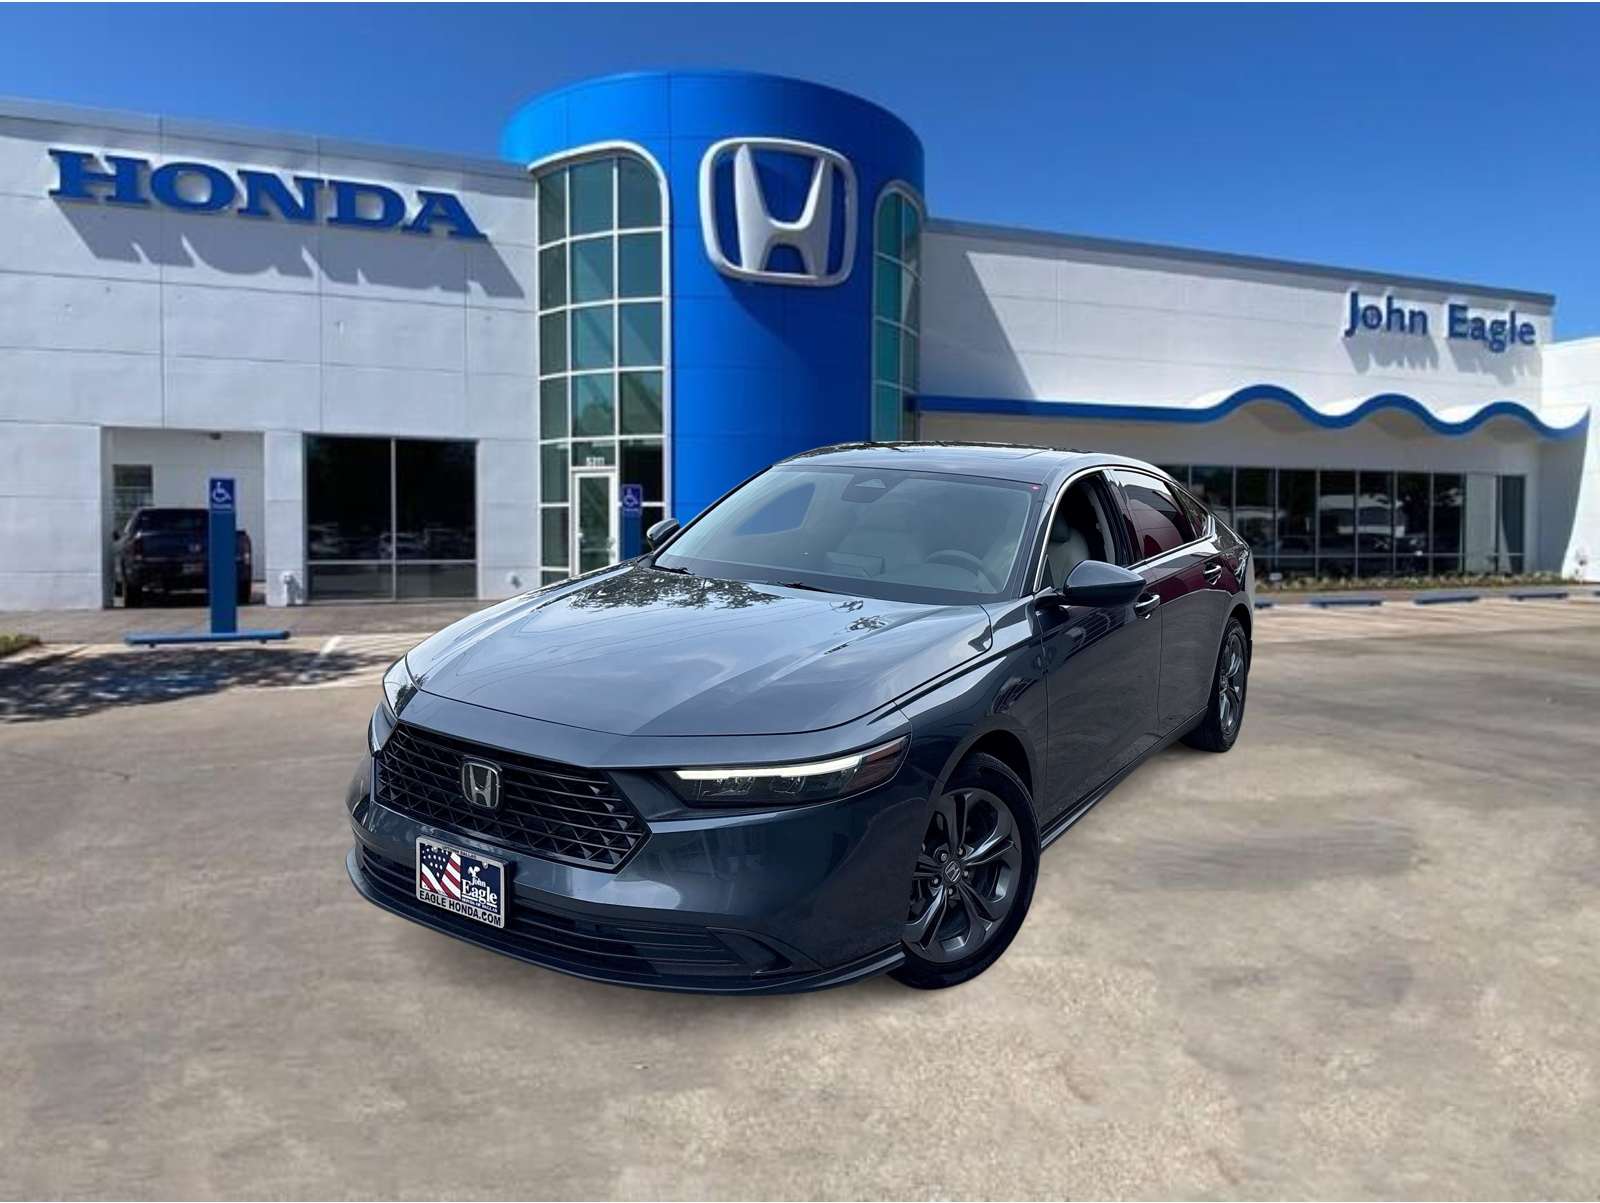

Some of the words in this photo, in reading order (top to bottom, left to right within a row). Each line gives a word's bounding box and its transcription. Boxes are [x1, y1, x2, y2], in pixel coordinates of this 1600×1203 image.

[48, 148, 488, 241] HONDA
[1344, 291, 1428, 338] John
[1448, 303, 1536, 353] Eagle
[461, 879, 498, 905] Eagle
[471, 877, 486, 887] John
[420, 891, 447, 906] EAGLE
[448, 899, 501, 926] HONDA.COM
